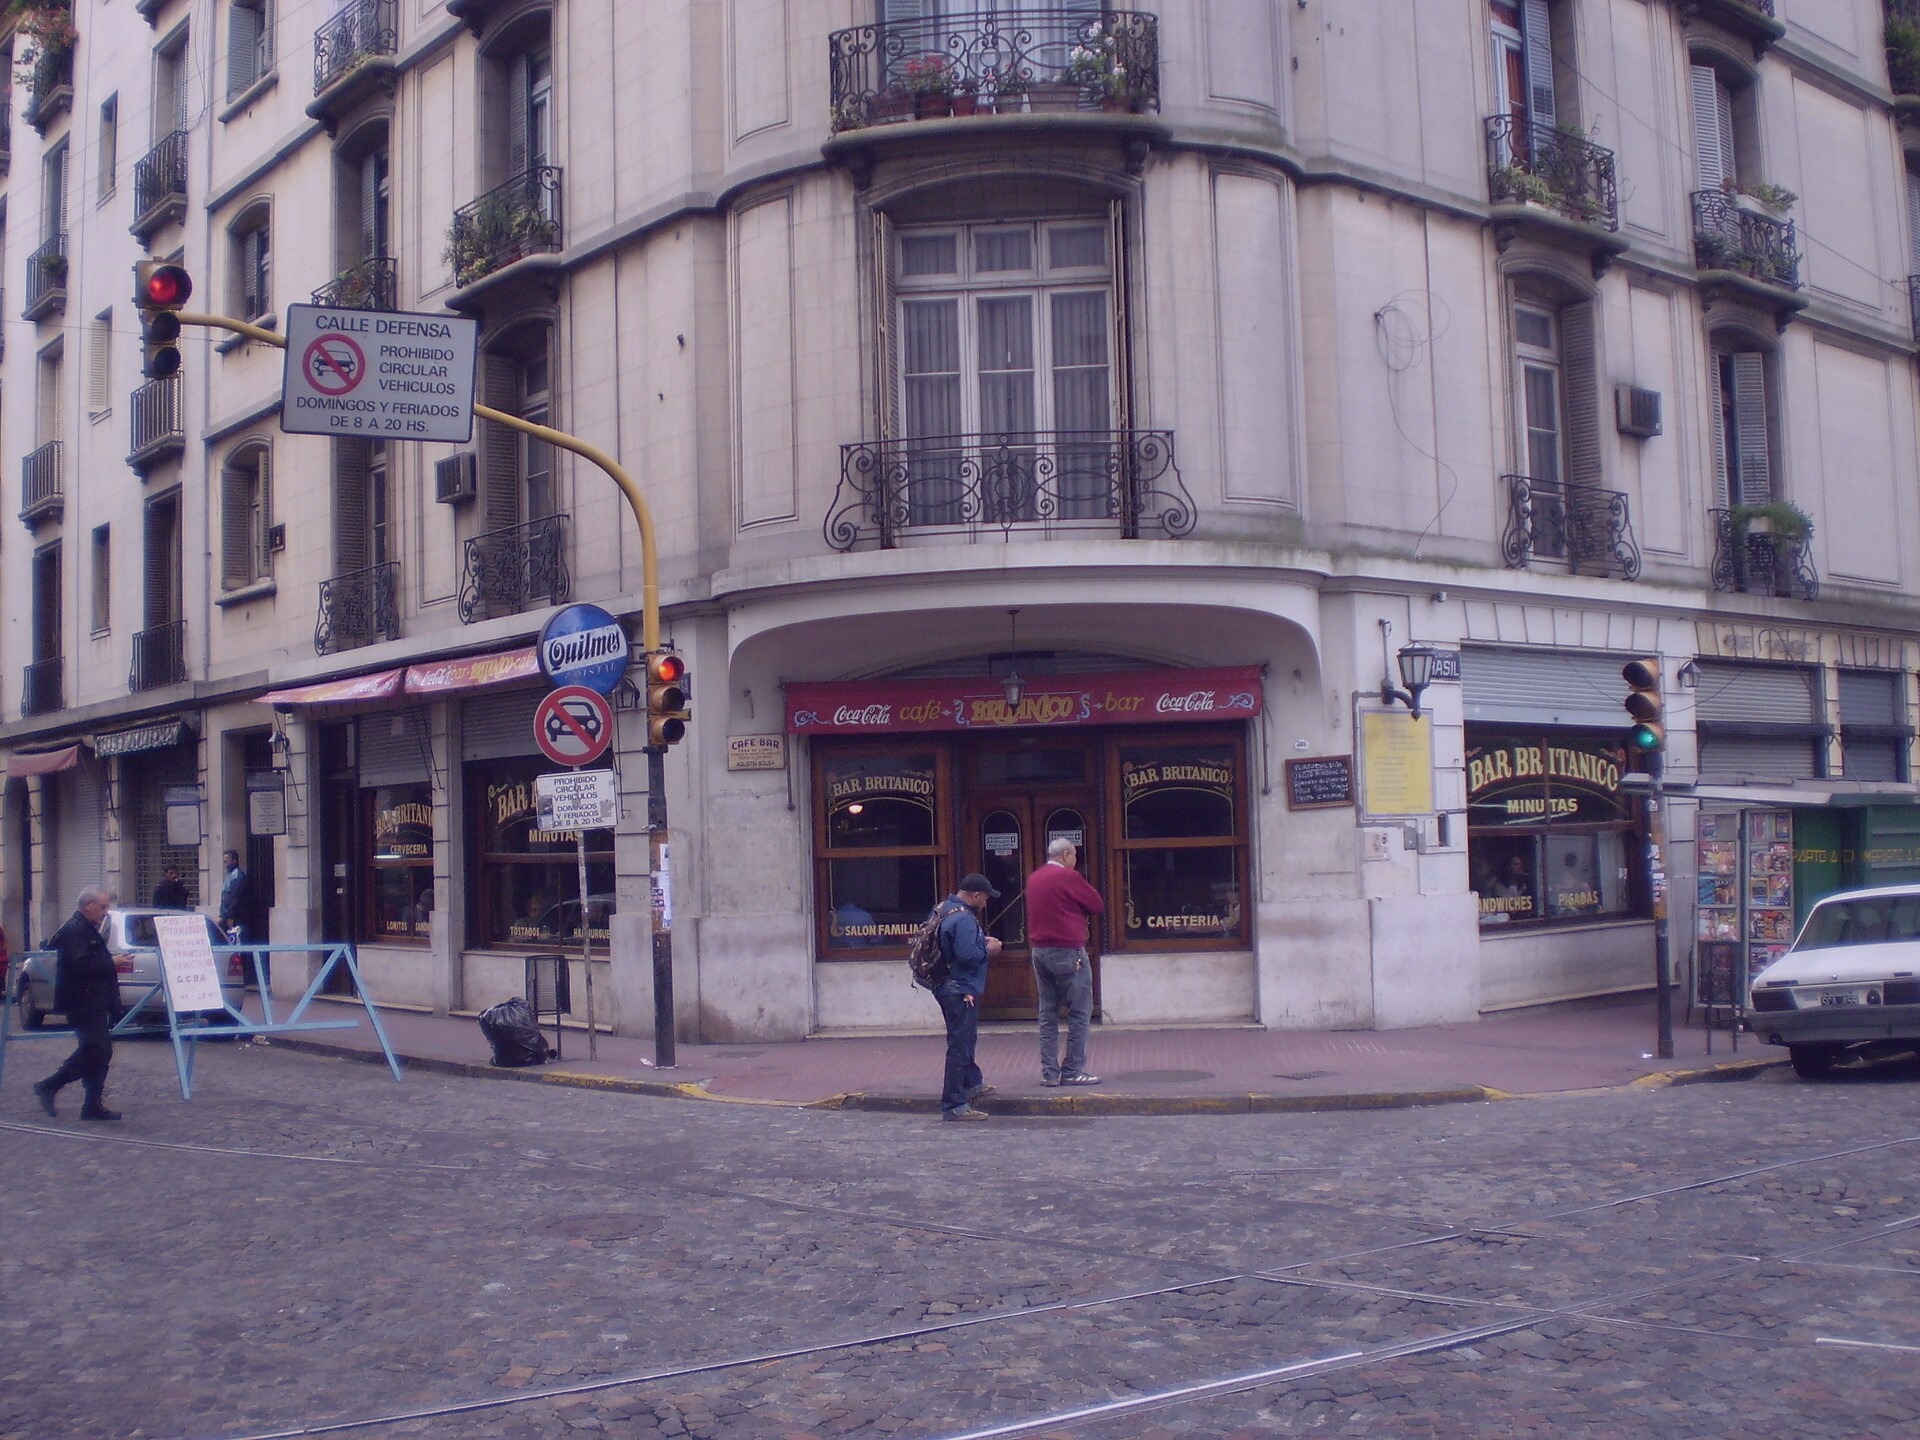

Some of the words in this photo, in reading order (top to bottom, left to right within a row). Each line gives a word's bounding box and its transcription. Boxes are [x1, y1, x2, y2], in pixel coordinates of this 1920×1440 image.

[315, 315, 369, 333] CALLE
[375, 320, 451, 338] DEFENSA
[379, 345, 454, 361] PROHIBIDO
[379, 362, 448, 377] CIRCULAR
[379, 379, 455, 395] VEHICULOS
[296, 397, 375, 412] DOMINGOS
[379, 402, 389, 413] Y
[392, 403, 460, 417] FERIADOS
[330, 415, 349, 427] DE
[354, 417, 363, 428] 8
[368, 417, 379, 429] A
[385, 418, 401, 431] 20
[406, 420, 429, 432] HS.
[549, 631, 620, 672] Quilmes
[833, 704, 892, 725] Coca-Cola
[1104, 692, 1145, 712] bar
[1156, 690, 1216, 713] Coca-Cola
[731, 738, 756, 750] CAFE
[759, 738, 780, 749] BAR
[1128, 768, 1160, 787] BAR
[1162, 765, 1229, 784] BRITANICO
[1469, 750, 1512, 792] BAR
[554, 775, 597, 785] PROHIBIDO
[832, 778, 862, 797] BAR
[865, 775, 931, 795] BRITANICO
[554, 792, 598, 801] VEHICULOS
[555, 784, 595, 793] CIRCULAR
[497, 783, 528, 824] BAR
[557, 803, 598, 812] DOMINGOS
[1506, 798, 1578, 814] MINUTAS
[564, 810, 599, 819] FERIADOS
[553, 820, 563, 828] DE
[1478, 895, 1533, 913] ANDWICHES
[1147, 915, 1220, 928] CAFETERIA
[510, 926, 540, 937] TOSTADOS
[844, 924, 876, 937] SALON
[878, 923, 924, 936] FAMILIA
